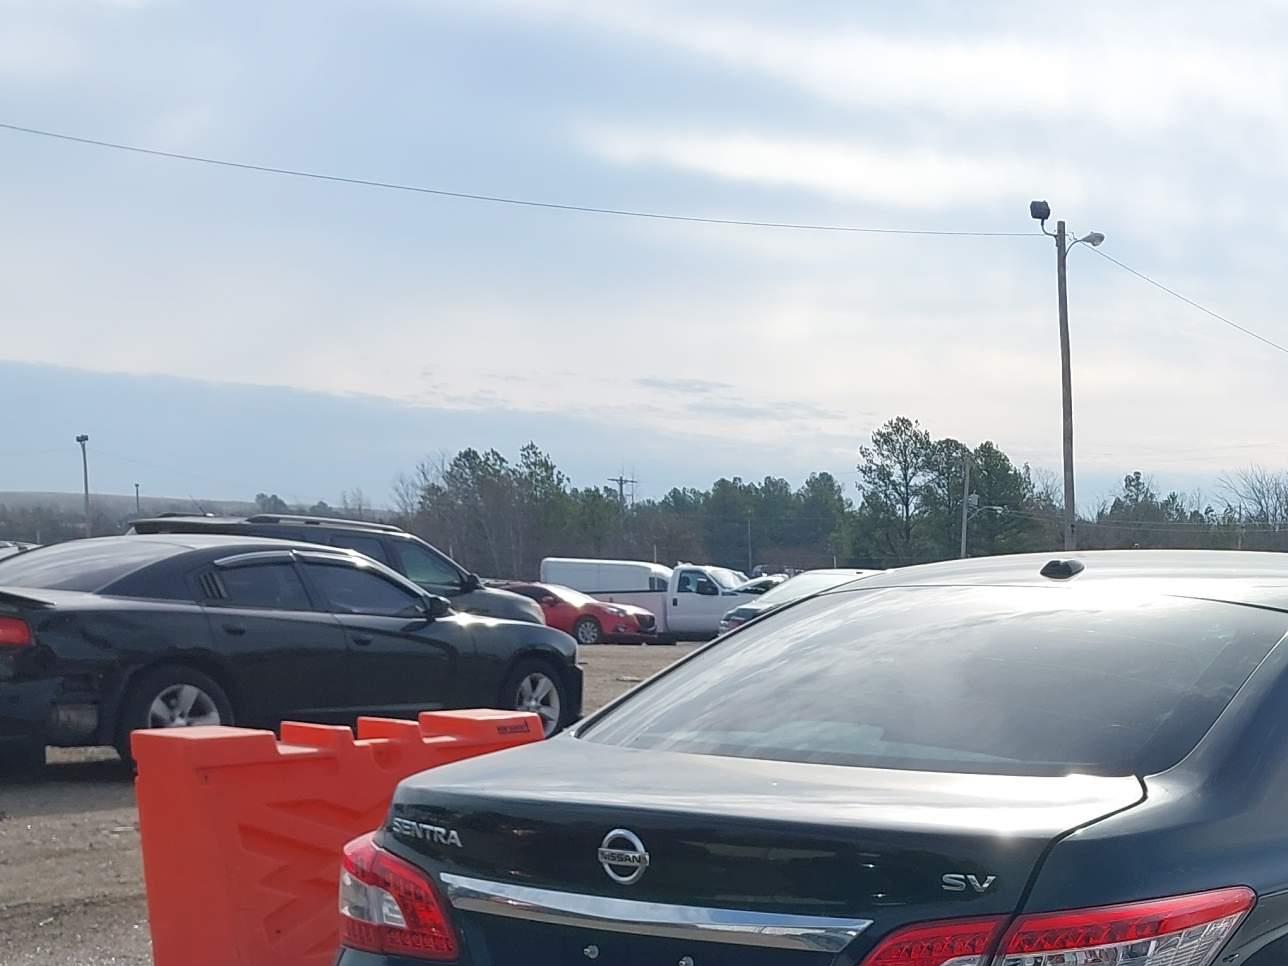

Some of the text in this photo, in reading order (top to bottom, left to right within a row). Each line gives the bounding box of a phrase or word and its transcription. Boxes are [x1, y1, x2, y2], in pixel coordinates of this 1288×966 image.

[392, 816, 464, 848] SENTRA
[600, 850, 642, 864] NISSAN
[941, 873, 997, 893] SV
